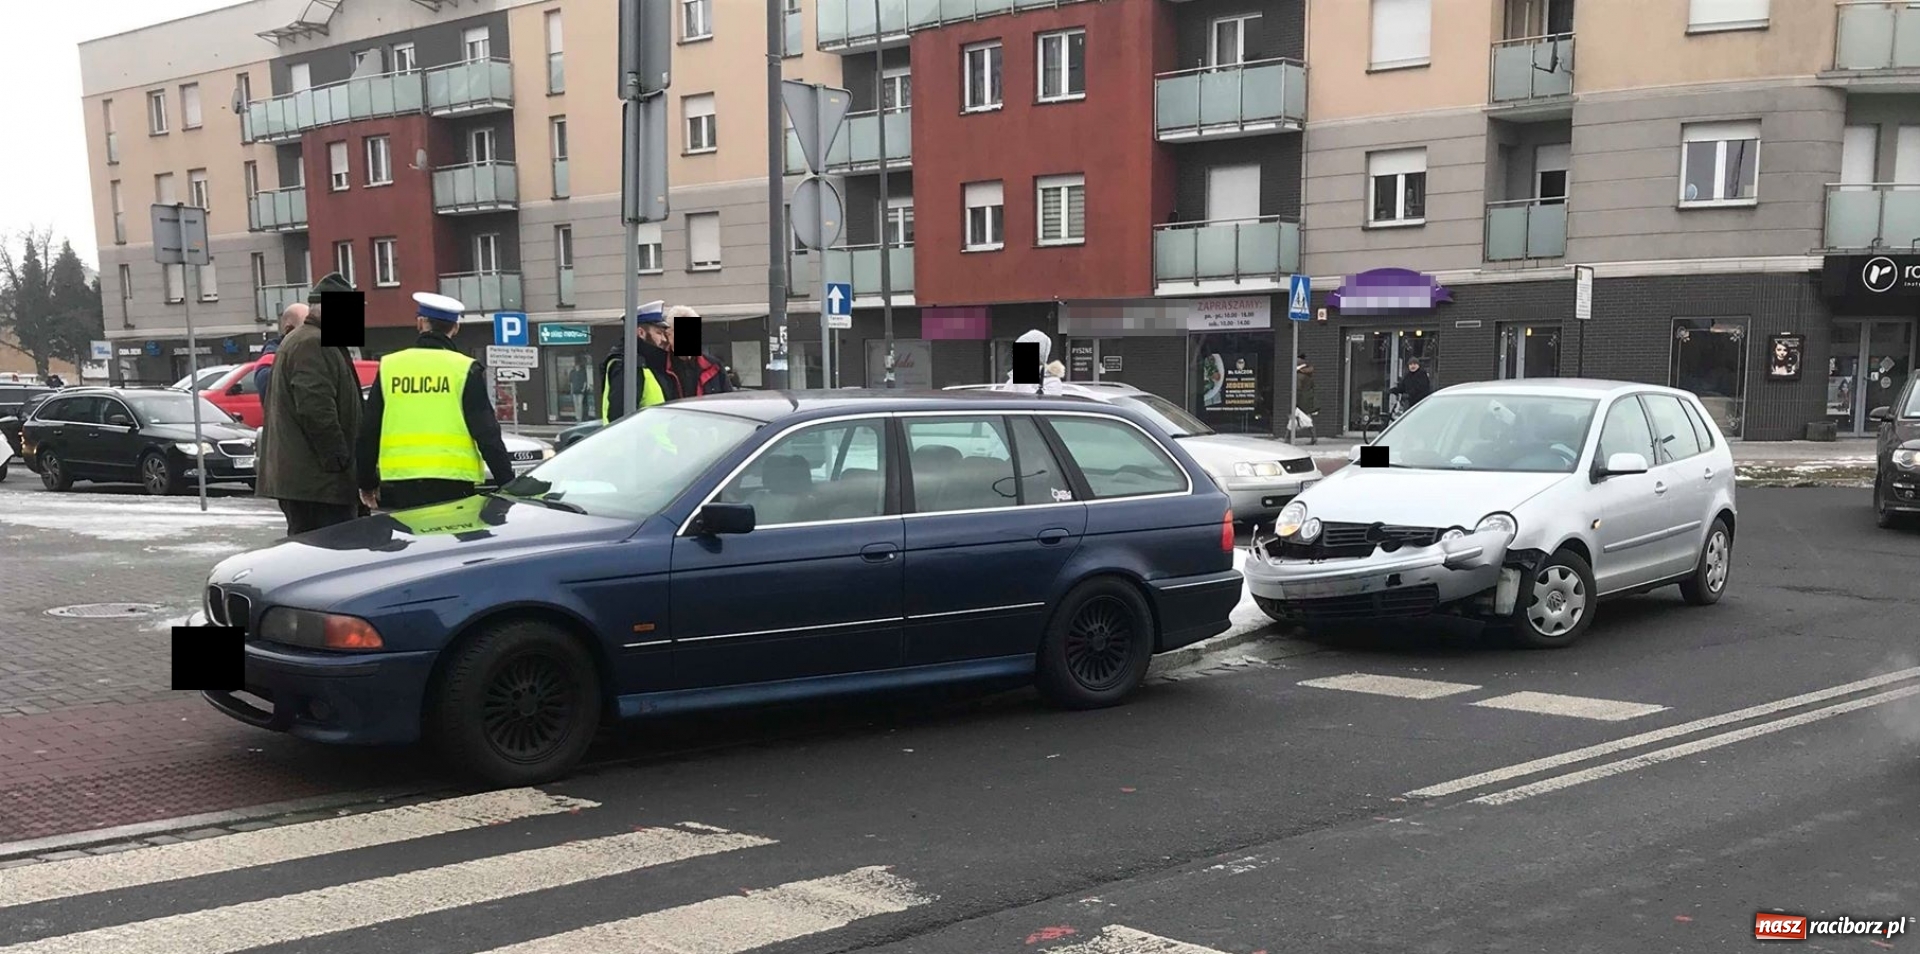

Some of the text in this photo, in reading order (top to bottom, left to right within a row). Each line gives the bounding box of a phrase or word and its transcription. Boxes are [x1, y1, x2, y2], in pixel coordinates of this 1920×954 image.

[1198, 299, 1262, 312] ZAPRASZAMY:
[502, 317, 521, 344] P
[392, 376, 450, 394] POLICJA
